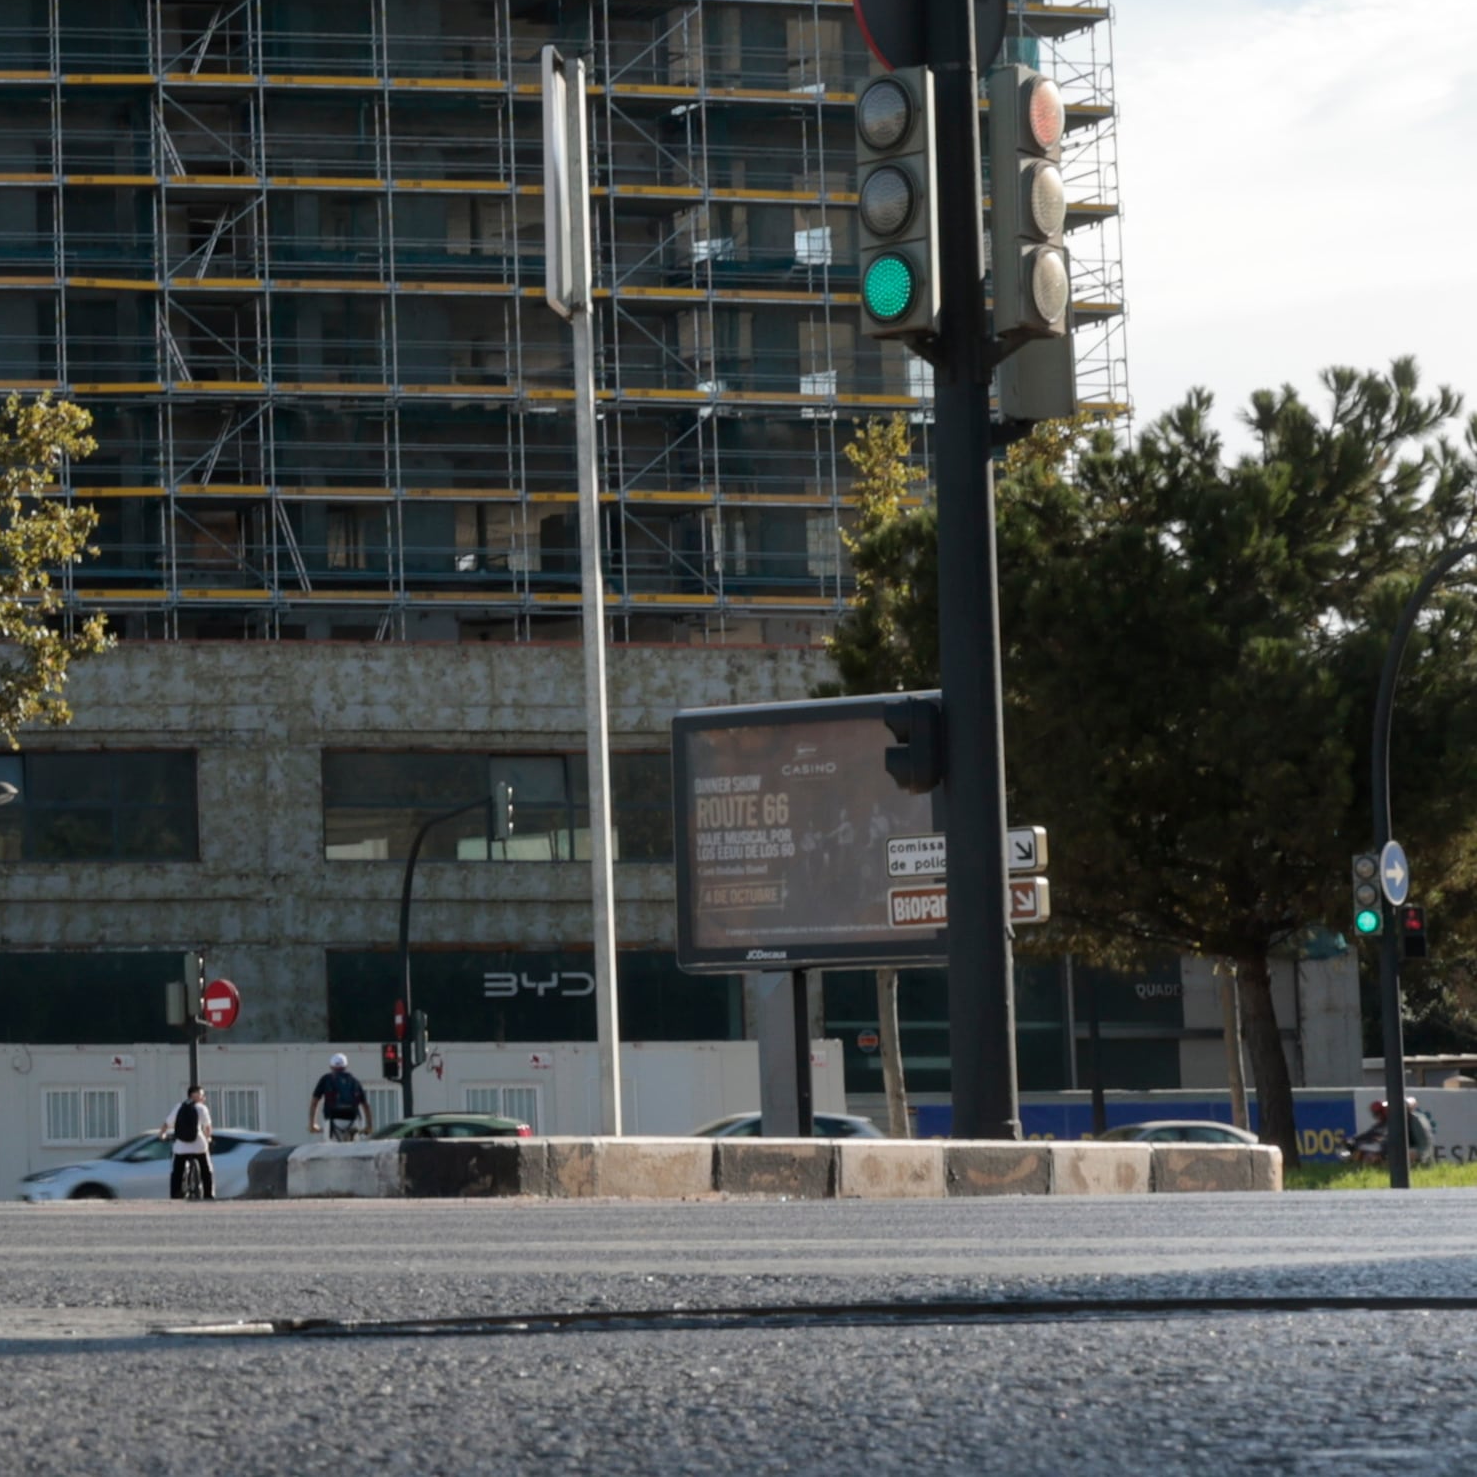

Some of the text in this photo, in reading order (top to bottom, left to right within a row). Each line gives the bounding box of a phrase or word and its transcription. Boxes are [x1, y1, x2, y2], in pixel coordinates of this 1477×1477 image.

[781, 763, 837, 776] CASINO
[697, 792, 790, 828] ROUTE 66
[724, 830, 768, 844] MUSICAL
[770, 828, 792, 843] POR
[696, 846, 716, 861] LOS
[744, 844, 759, 859] DE
[760, 843, 780, 858] LOS
[891, 860, 906, 871] de
[483, 972, 595, 997] BYD
